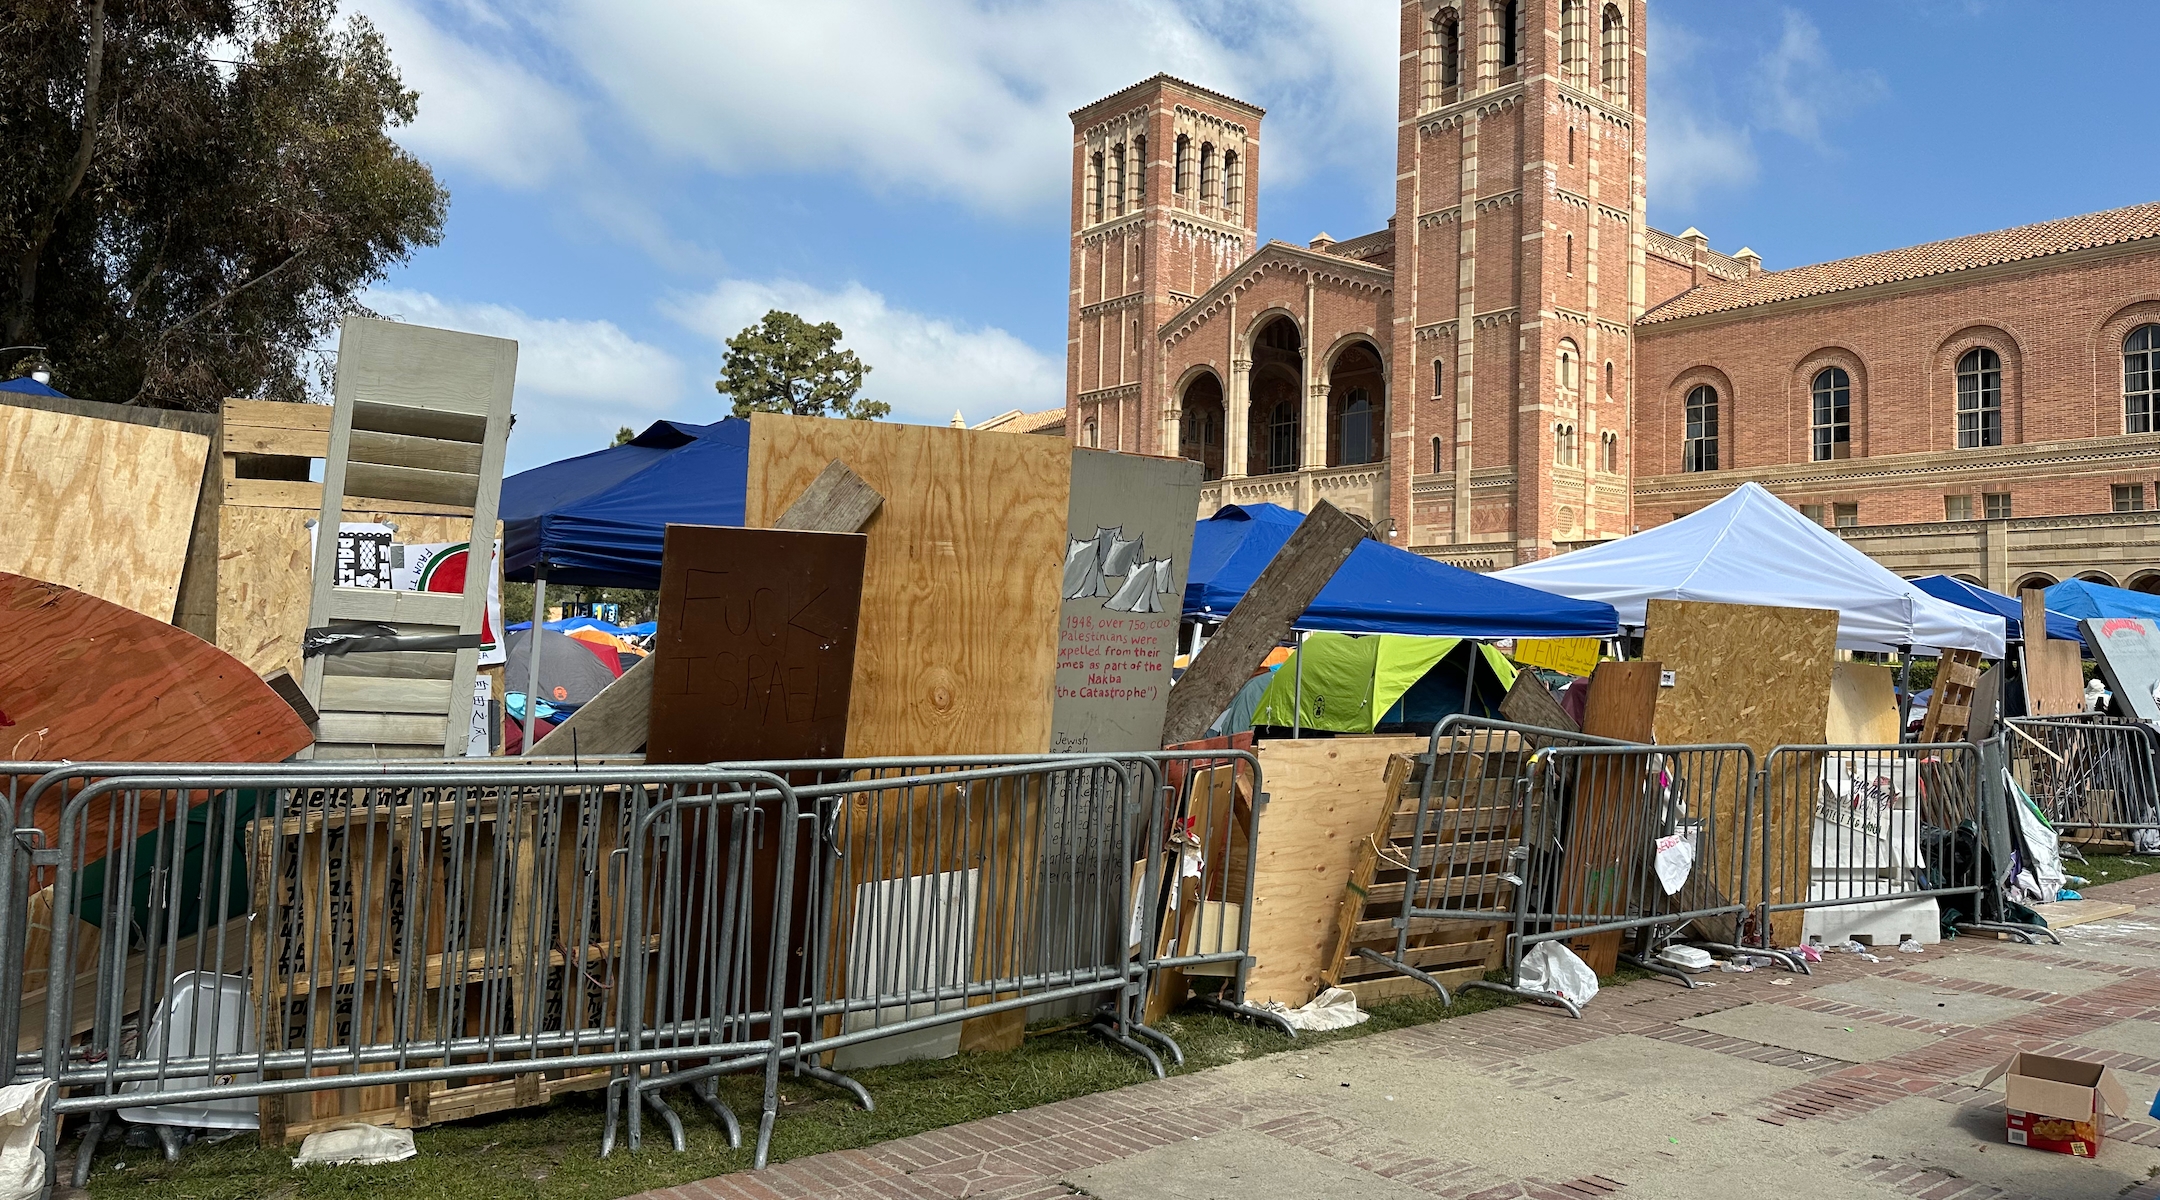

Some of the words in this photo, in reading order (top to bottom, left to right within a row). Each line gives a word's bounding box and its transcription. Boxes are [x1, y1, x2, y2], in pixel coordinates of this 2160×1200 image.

[413, 548, 433, 575] FROM
[680, 568, 830, 658] FUCK
[1066, 616, 1095, 631] 1948,
[1098, 619, 1124, 629] over
[1061, 630, 1128, 643] Palestinians
[1131, 635, 1158, 645] were
[1105, 646, 1131, 656] from
[1134, 646, 1160, 658] their
[1056, 660, 1084, 669] omes
[1089, 661, 1100, 670] as
[1103, 661, 1127, 673] part
[1130, 660, 1141, 670] of
[1144, 661, 1162, 672] the
[1088, 673, 1122, 686] Nakba
[665, 652, 841, 727] ISRAEL
[1079, 685, 1158, 701] Catastrophe")
[1055, 732, 1088, 745] Jewish
